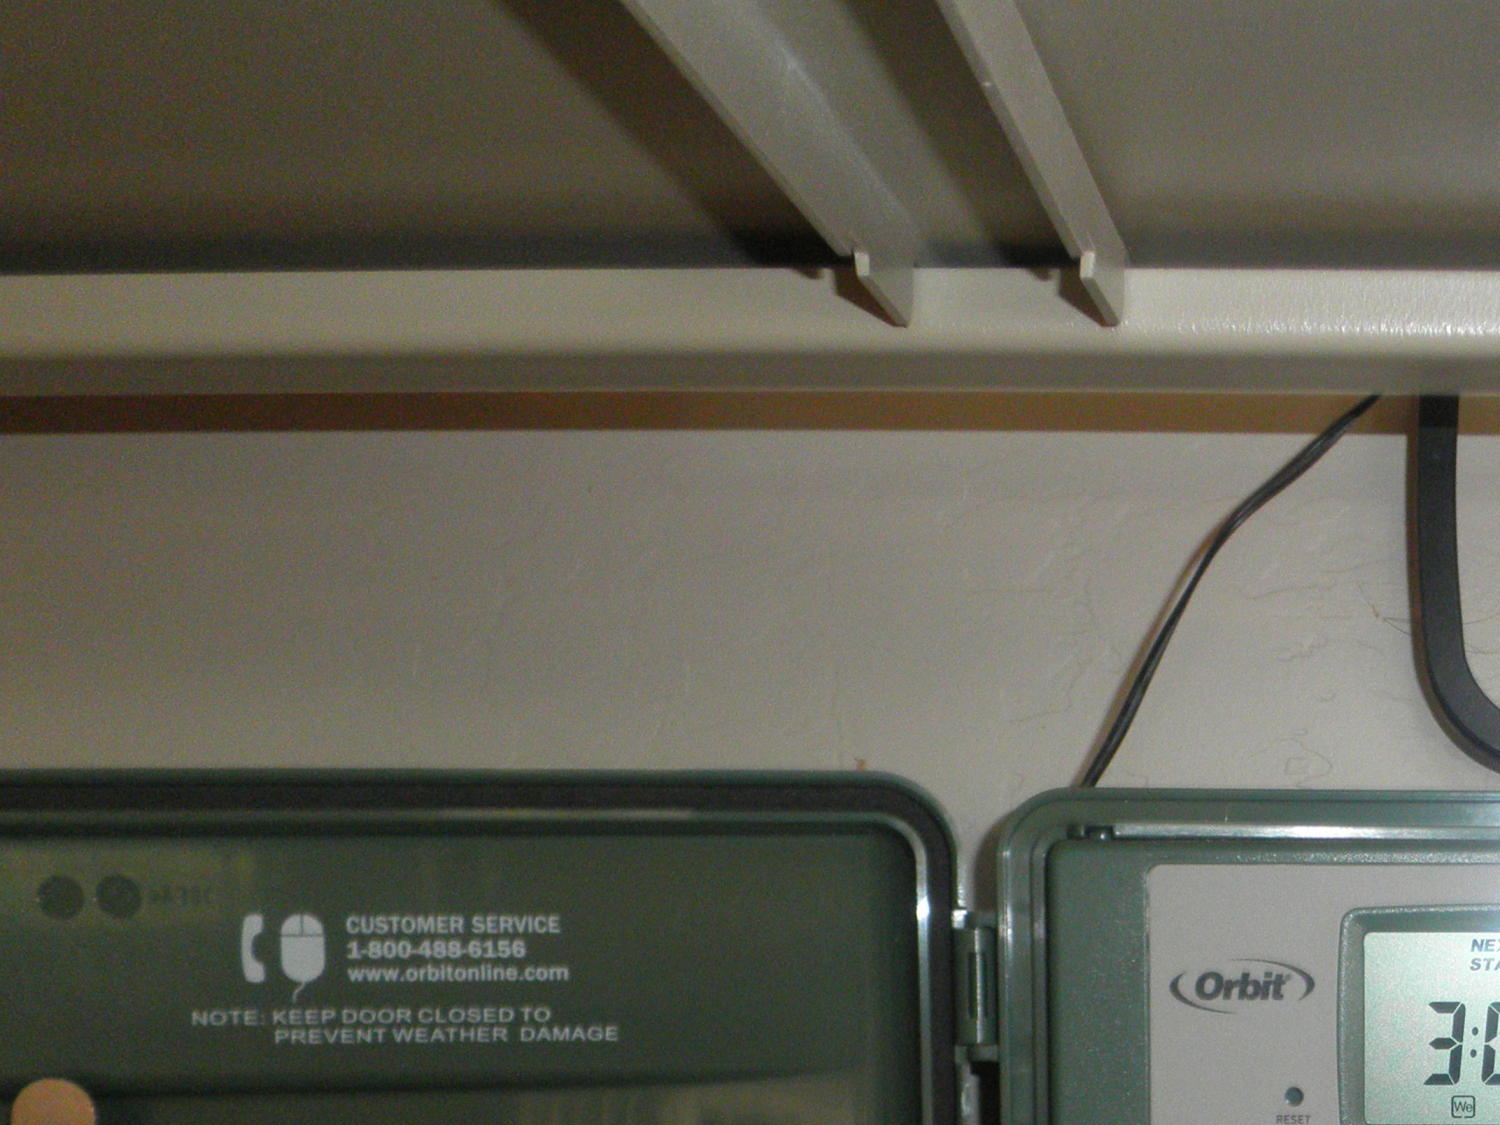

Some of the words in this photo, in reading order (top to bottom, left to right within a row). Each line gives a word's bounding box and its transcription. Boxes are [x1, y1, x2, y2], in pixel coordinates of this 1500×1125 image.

[346, 916, 464, 935] CUSTOMER
[471, 915, 561, 934] SERVICE
[347, 940, 526, 960] 1-800-488-6156
[347, 963, 570, 983] www.orbitonline.com
[1194, 970, 1286, 1001] Orbit
[272, 1008, 336, 1025] KEEP
[341, 1007, 412, 1024] DOOR
[417, 1006, 515, 1023] CLOSED
[519, 1006, 551, 1023] TO
[274, 1028, 386, 1045] PREVENT
[392, 1027, 509, 1044] WEATHER
[519, 1025, 620, 1042] DAMAGE
[1454, 1100, 1473, 1113] We
[1275, 1114, 1311, 1125] RESET
